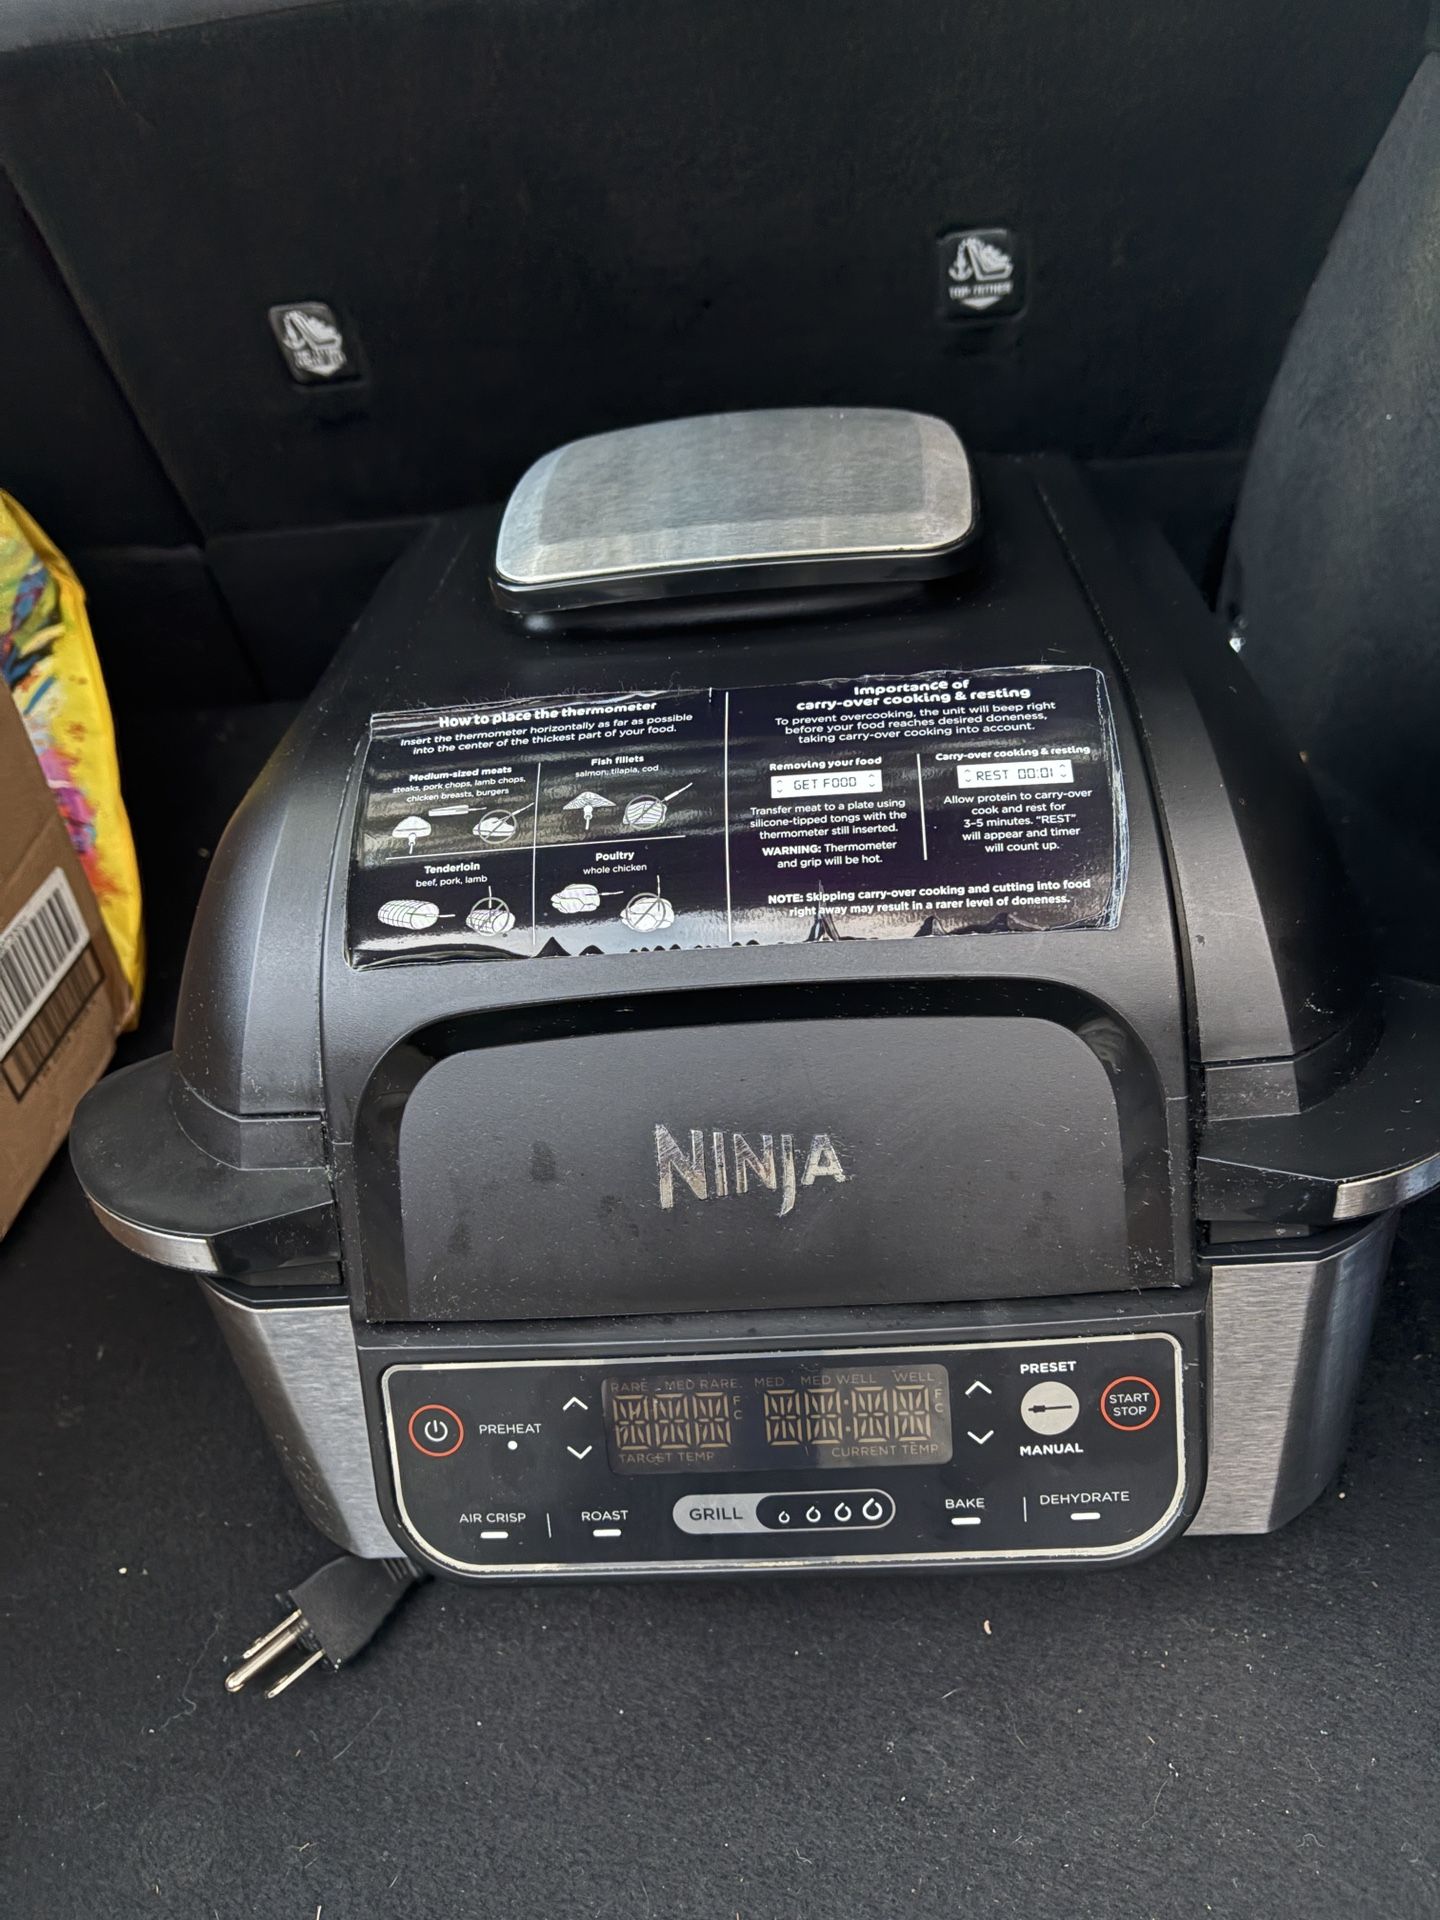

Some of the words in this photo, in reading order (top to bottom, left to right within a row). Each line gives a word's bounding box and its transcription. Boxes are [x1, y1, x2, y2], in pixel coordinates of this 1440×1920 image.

[854, 680, 949, 695] Importance
[952, 680, 970, 689] of
[797, 698, 879, 710] carry-over
[883, 692, 951, 704] cooking
[955, 692, 967, 700] &
[970, 688, 1031, 699] resting
[439, 716, 472, 728] How
[474, 714, 489, 725] to
[492, 712, 531, 725] place
[534, 708, 558, 720] the
[562, 702, 657, 717] thermometer
[792, 715, 836, 725] prevent
[840, 710, 916, 721] overcooking,
[969, 705, 988, 714] will
[993, 704, 1023, 712] beep
[1027, 702, 1056, 711] right
[401, 737, 431, 746] Insert
[456, 727, 527, 741] thermometer
[530, 721, 595, 734] horizontally
[647, 714, 693, 725] possible
[785, 726, 823, 734] before
[827, 724, 853, 733] your
[857, 721, 884, 729] food
[888, 718, 935, 728] reaches
[938, 715, 982, 724] desired
[986, 713, 1047, 722] doneness,
[438, 744, 455, 752] the
[458, 741, 493, 750] center
[511, 738, 529, 746] the
[532, 733, 575, 744] thickest
[579, 731, 601, 740] part
[619, 728, 644, 737] your
[648, 725, 676, 734] food.
[798, 734, 835, 743] taking
[839, 731, 900, 740] carry-over
[904, 727, 952, 737] cooking
[956, 726, 979, 734] into
[983, 723, 1035, 732] account.
[936, 751, 991, 761] Carry-over
[994, 749, 1038, 758] cooking
[1051, 746, 1090, 755] resting
[591, 758, 612, 766] Fish
[616, 756, 644, 764] fillets
[770, 761, 826, 771] Removing
[828, 759, 853, 769] your
[856, 756, 882, 765] food
[409, 769, 479, 781] Medium-sized
[482, 766, 512, 775] meats
[611, 767, 639, 775] tilapia,
[976, 770, 1008, 781] REST
[423, 783, 443, 791] pork
[445, 782, 472, 790] chops,
[498, 776, 526, 784] chops,
[794, 779, 818, 790] GET
[824, 777, 856, 788] FOOD
[441, 791, 474, 799] breasts,
[476, 788, 509, 796] burgers
[944, 796, 974, 804] Allow
[977, 793, 1017, 803] protein
[1020, 792, 1032, 800] to
[1035, 790, 1092, 800] carry-over
[750, 806, 792, 815] Transfer
[795, 804, 821, 812] meat
[848, 801, 874, 810] plate
[877, 800, 905, 808] using
[972, 806, 999, 815] cook
[1002, 805, 1022, 813] and
[1026, 803, 1047, 812] rest
[1050, 802, 1066, 810] for
[750, 815, 827, 828] silicone-tipped
[830, 812, 860, 823] tongs
[863, 812, 886, 821] with
[889, 811, 907, 819] the
[987, 817, 1033, 826] minutes.
[760, 828, 829, 839] thermometer
[832, 826, 849, 835] still
[853, 824, 898, 834] inserted.
[962, 832, 980, 841] will
[984, 830, 1023, 840] appear
[1026, 828, 1047, 837] and
[1050, 827, 1080, 836] timer
[762, 845, 821, 856] WARNING:
[824, 841, 897, 852] Thermometer
[985, 844, 1003, 852] will
[1007, 842, 1039, 851] count
[1042, 842, 1059, 852] up.
[596, 850, 634, 862] Poultry
[777, 859, 797, 868] and
[800, 858, 822, 868] grip
[825, 856, 842, 865] will
[845, 856, 859, 864] be
[862, 855, 882, 863] hot.
[425, 862, 480, 874] Tenderloin
[583, 865, 610, 875] whole
[612, 864, 647, 873] chicken
[416, 879, 437, 887] beef,
[440, 877, 463, 887] pork,
[465, 875, 487, 883] lamb
[768, 894, 803, 904] NOTE:
[806, 891, 855, 902] Skipping
[858, 889, 916, 900] carry-over
[919, 886, 965, 896] cooking
[968, 884, 990, 894] and
[993, 882, 1034, 893] cutting
[1037, 881, 1060, 890] into
[1063, 879, 1091, 889] food
[789, 907, 816, 917] right
[819, 906, 847, 916] away
[851, 904, 874, 914] may
[877, 901, 909, 911] result
[912, 901, 922, 909] in
[936, 900, 963, 909] rarer
[966, 897, 993, 907] level
[996, 897, 1009, 906] of
[1012, 895, 1070, 905] doneness.
[655, 1124, 846, 1217] NINJA
[1020, 1361, 1076, 1374] PRESET
[894, 1372, 935, 1382] WELL
[1109, 1393, 1150, 1404] START
[1113, 1406, 1146, 1416] STOP
[479, 1424, 541, 1434] PREHEAT
[832, 1446, 896, 1457] CURRENT
[902, 1444, 939, 1454] TEMP
[1020, 1443, 1083, 1456] MANUAL
[619, 1453, 672, 1463] TARGET
[945, 1498, 985, 1509] BAKE
[1040, 1491, 1130, 1505] DEHYDRATE
[460, 1513, 483, 1523] AIR
[487, 1512, 526, 1522] CRISP
[582, 1510, 628, 1521] ROAST
[689, 1508, 743, 1520] GRILL
